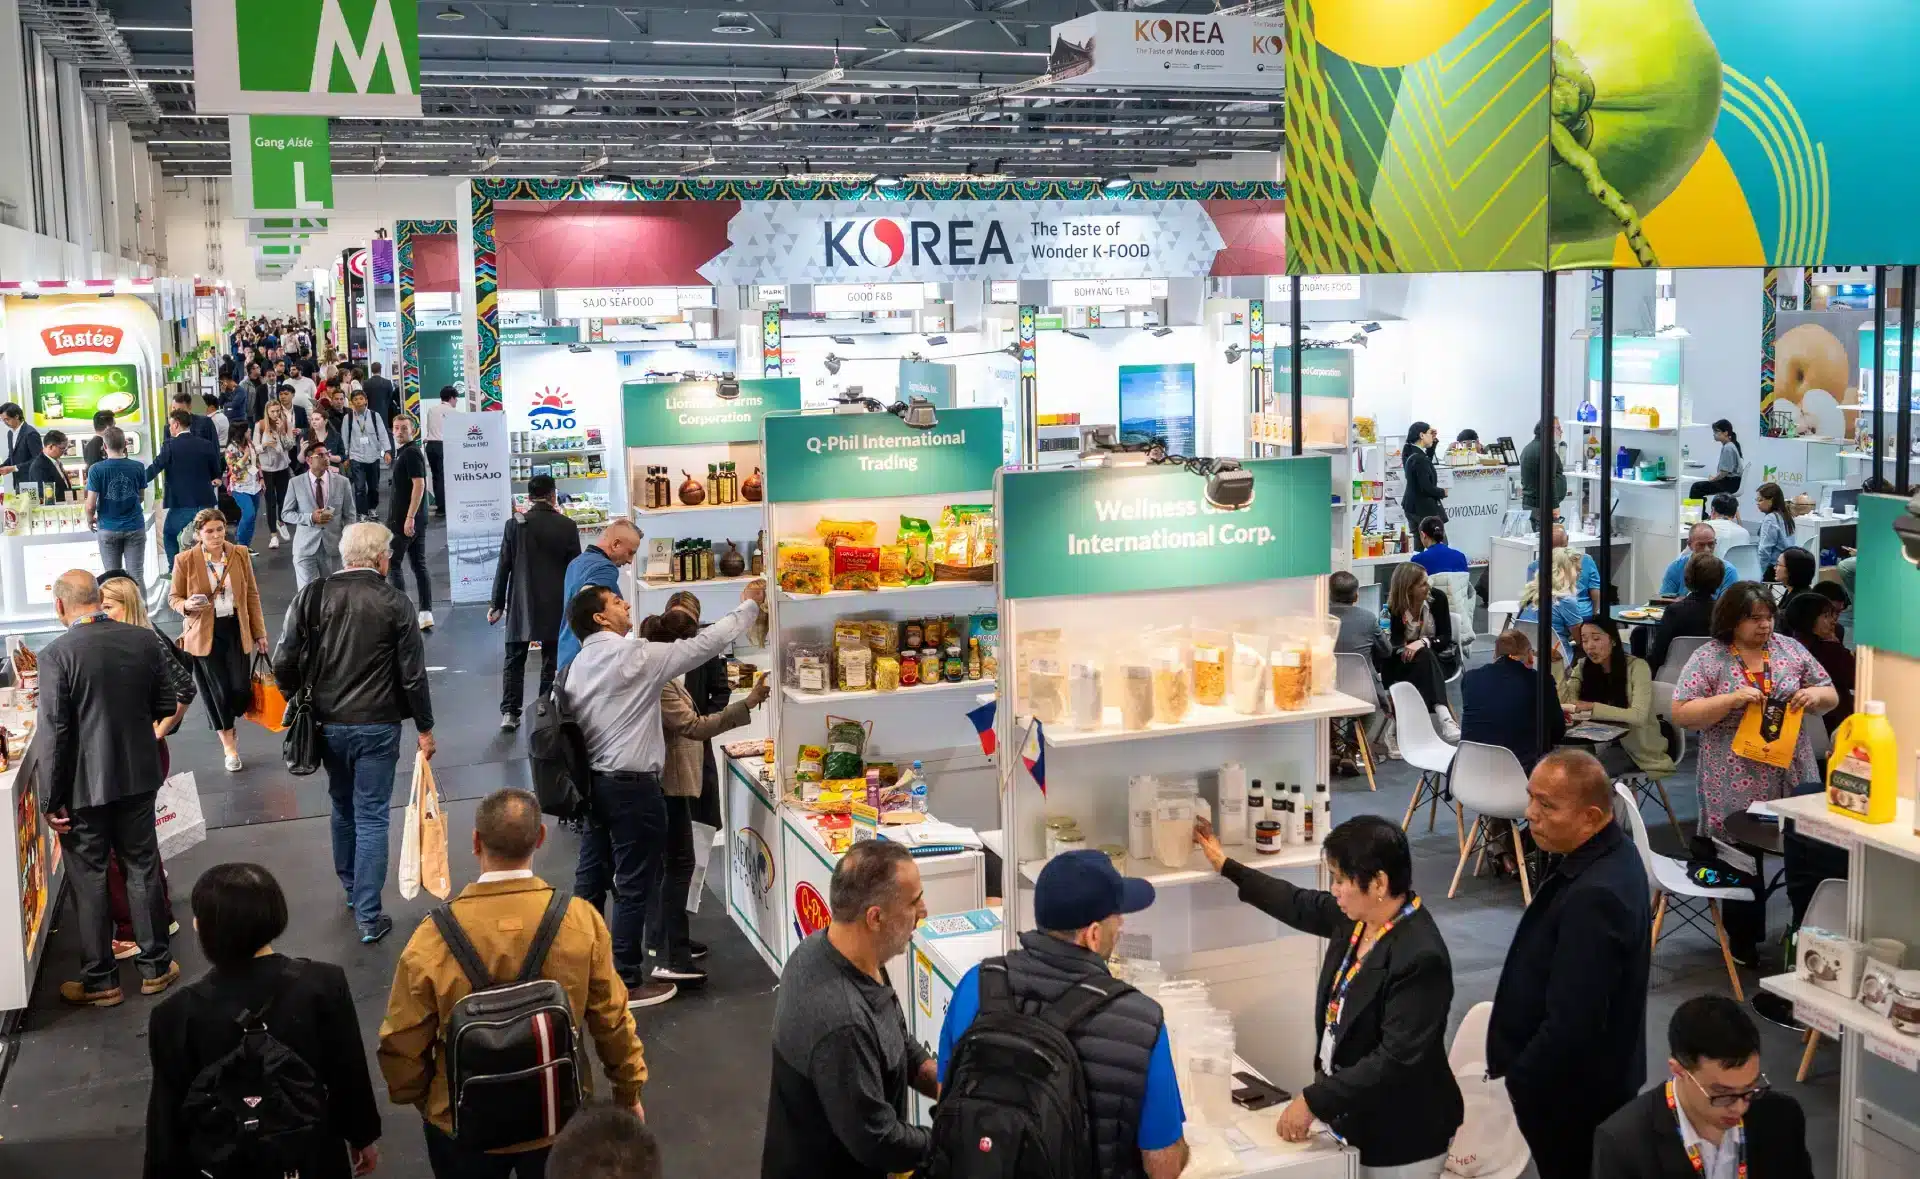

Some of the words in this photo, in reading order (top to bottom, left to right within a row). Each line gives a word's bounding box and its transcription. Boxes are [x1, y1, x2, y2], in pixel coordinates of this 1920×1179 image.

[1135, 19, 1224, 44] KOREA
[309, 0, 413, 94] M
[1175, 48, 1198, 56] Wonder
[254, 136, 284, 150] Gang
[286, 136, 313, 148] Aisle
[293, 161, 324, 210] L
[1031, 221, 1059, 238] The
[1062, 221, 1103, 238] Taste
[1106, 220, 1120, 237] of
[824, 217, 1014, 268] KOREA
[1031, 243, 1089, 260] Wonder
[1092, 242, 1150, 260] K-FOOD
[1074, 287, 1113, 297] BOHYANG
[1115, 286, 1130, 296] TEA
[1332, 283, 1352, 291] FOOD
[582, 298, 607, 308] SAJO
[609, 297, 654, 307] SEAFOOD
[847, 292, 873, 302] GOOD
[875, 291, 893, 301] F&B
[436, 319, 463, 327] PATEN
[499, 317, 520, 325] TENT
[49, 328, 115, 349] Tastée
[39, 374, 72, 384] READY
[531, 417, 577, 431] SAJO
[679, 412, 751, 426] Corporation
[806, 435, 859, 454] Q-Phil
[862, 429, 966, 450] International
[463, 461, 489, 471] Enjoy
[858, 453, 918, 472] Trading
[453, 473, 475, 481] With
[475, 471, 502, 480] SAJO
[1778, 471, 1803, 482] PEAR
[1095, 496, 1197, 522] Wellness
[1068, 525, 1215, 556] International
[1218, 523, 1276, 546] Corp.
[733, 830, 760, 883] MEGA
[733, 860, 769, 910] GLOBAL
